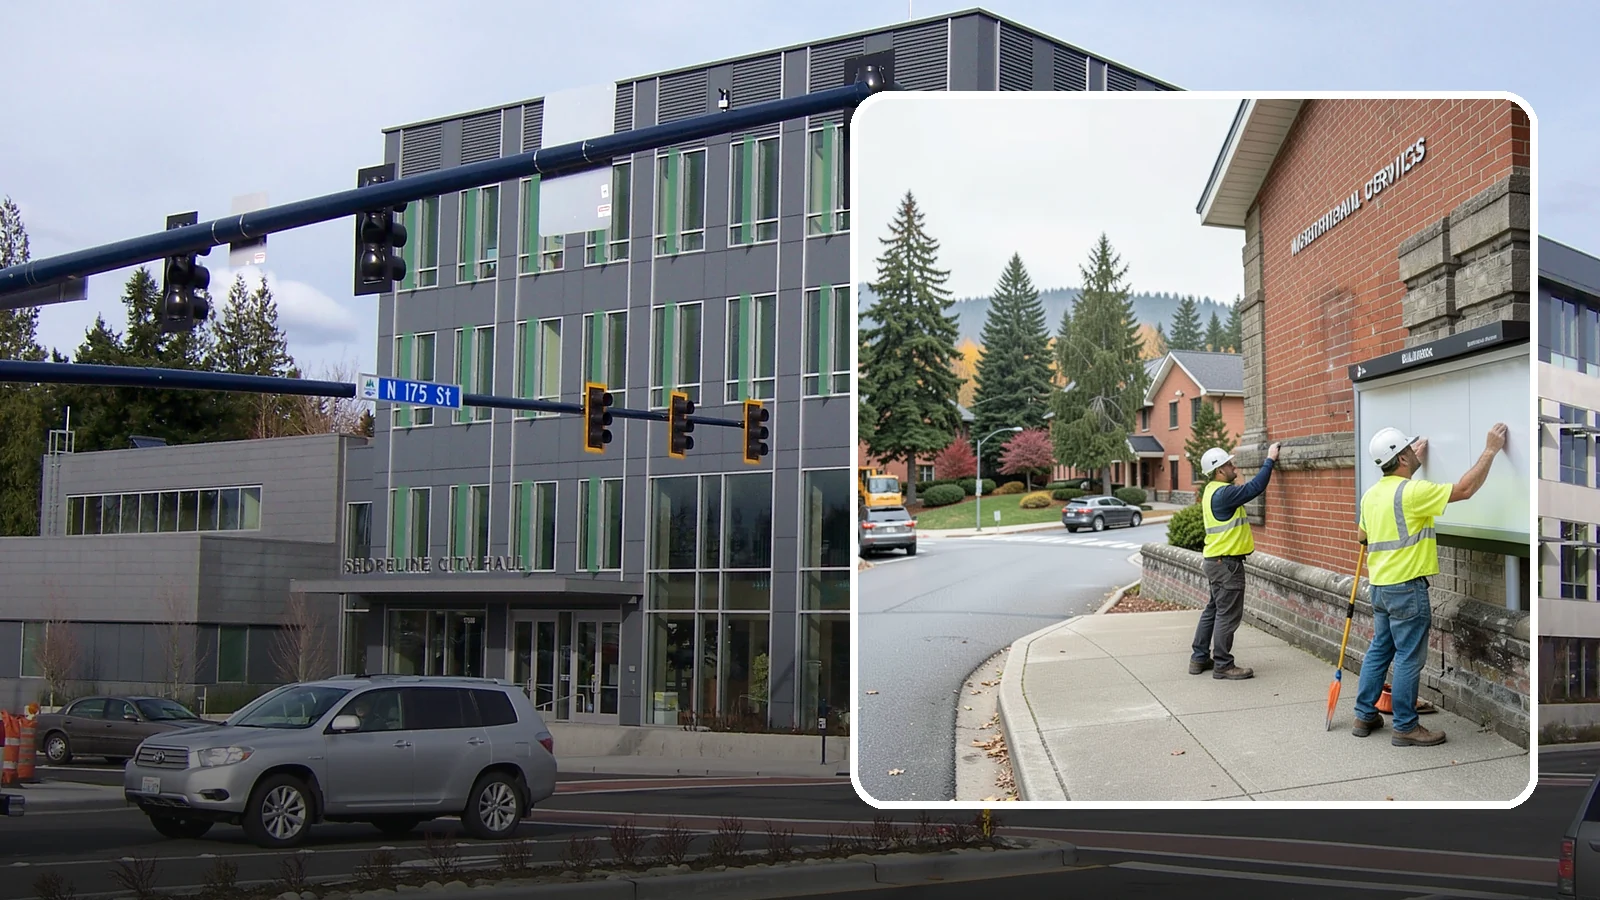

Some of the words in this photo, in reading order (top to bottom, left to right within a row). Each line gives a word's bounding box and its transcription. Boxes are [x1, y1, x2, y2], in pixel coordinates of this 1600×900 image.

[387, 380, 396, 400] N
[405, 382, 427, 403] 175
[436, 386, 451, 406] St
[344, 556, 432, 574] SHORELINE
[439, 556, 476, 574] CITY
[484, 555, 525, 573] HALL
